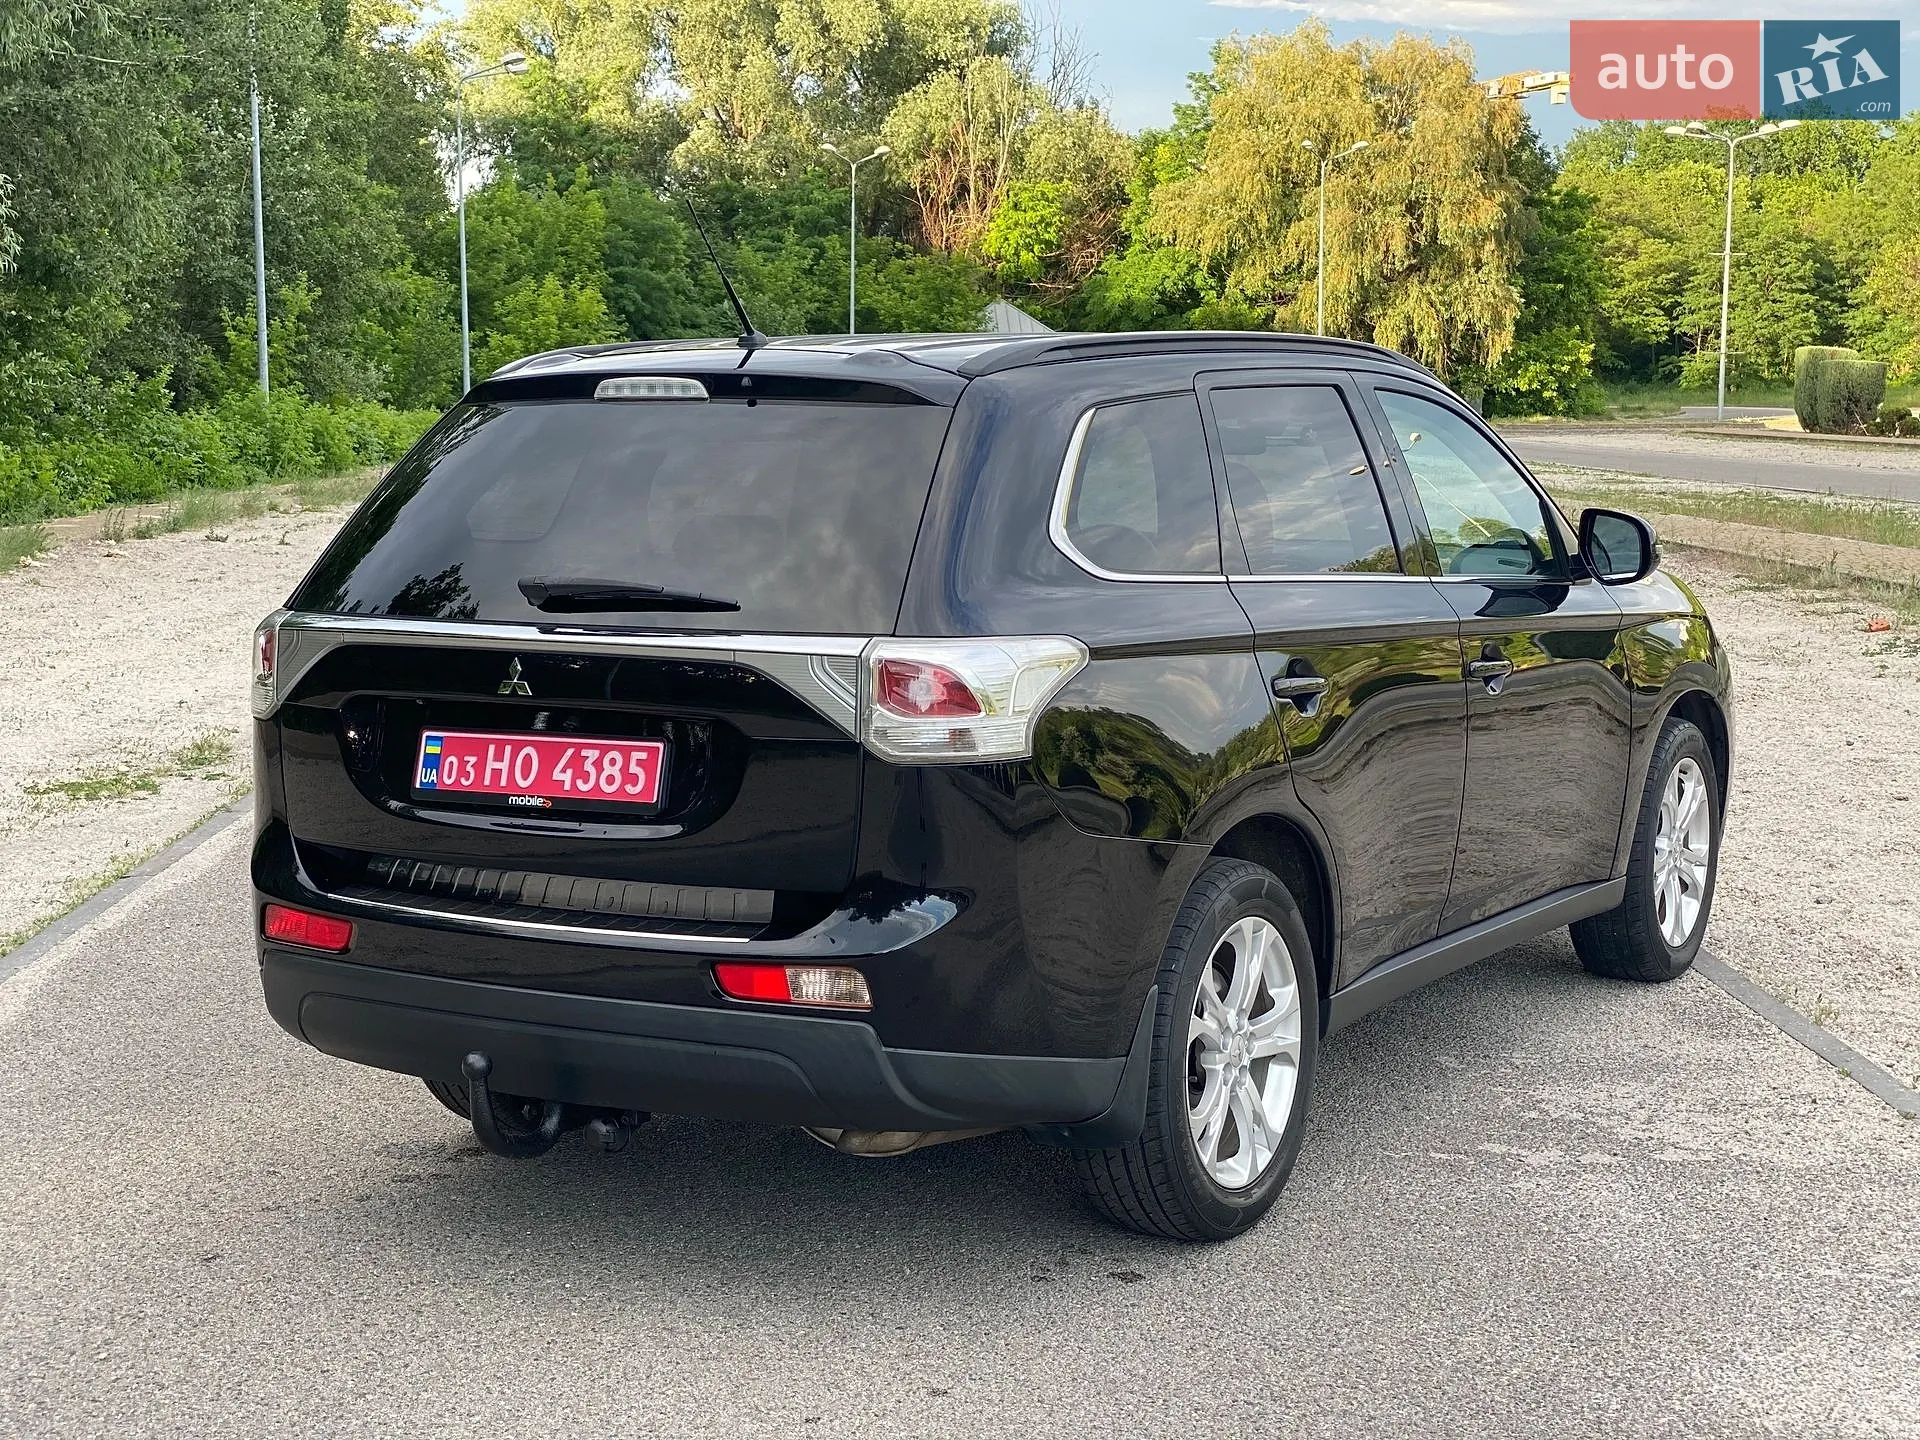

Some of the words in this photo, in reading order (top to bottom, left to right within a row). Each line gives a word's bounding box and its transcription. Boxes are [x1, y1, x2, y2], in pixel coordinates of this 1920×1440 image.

[421, 768, 437, 783] UA
[442, 755, 478, 787] 03
[483, 744, 539, 789] HO
[551, 748, 648, 794] 4385
